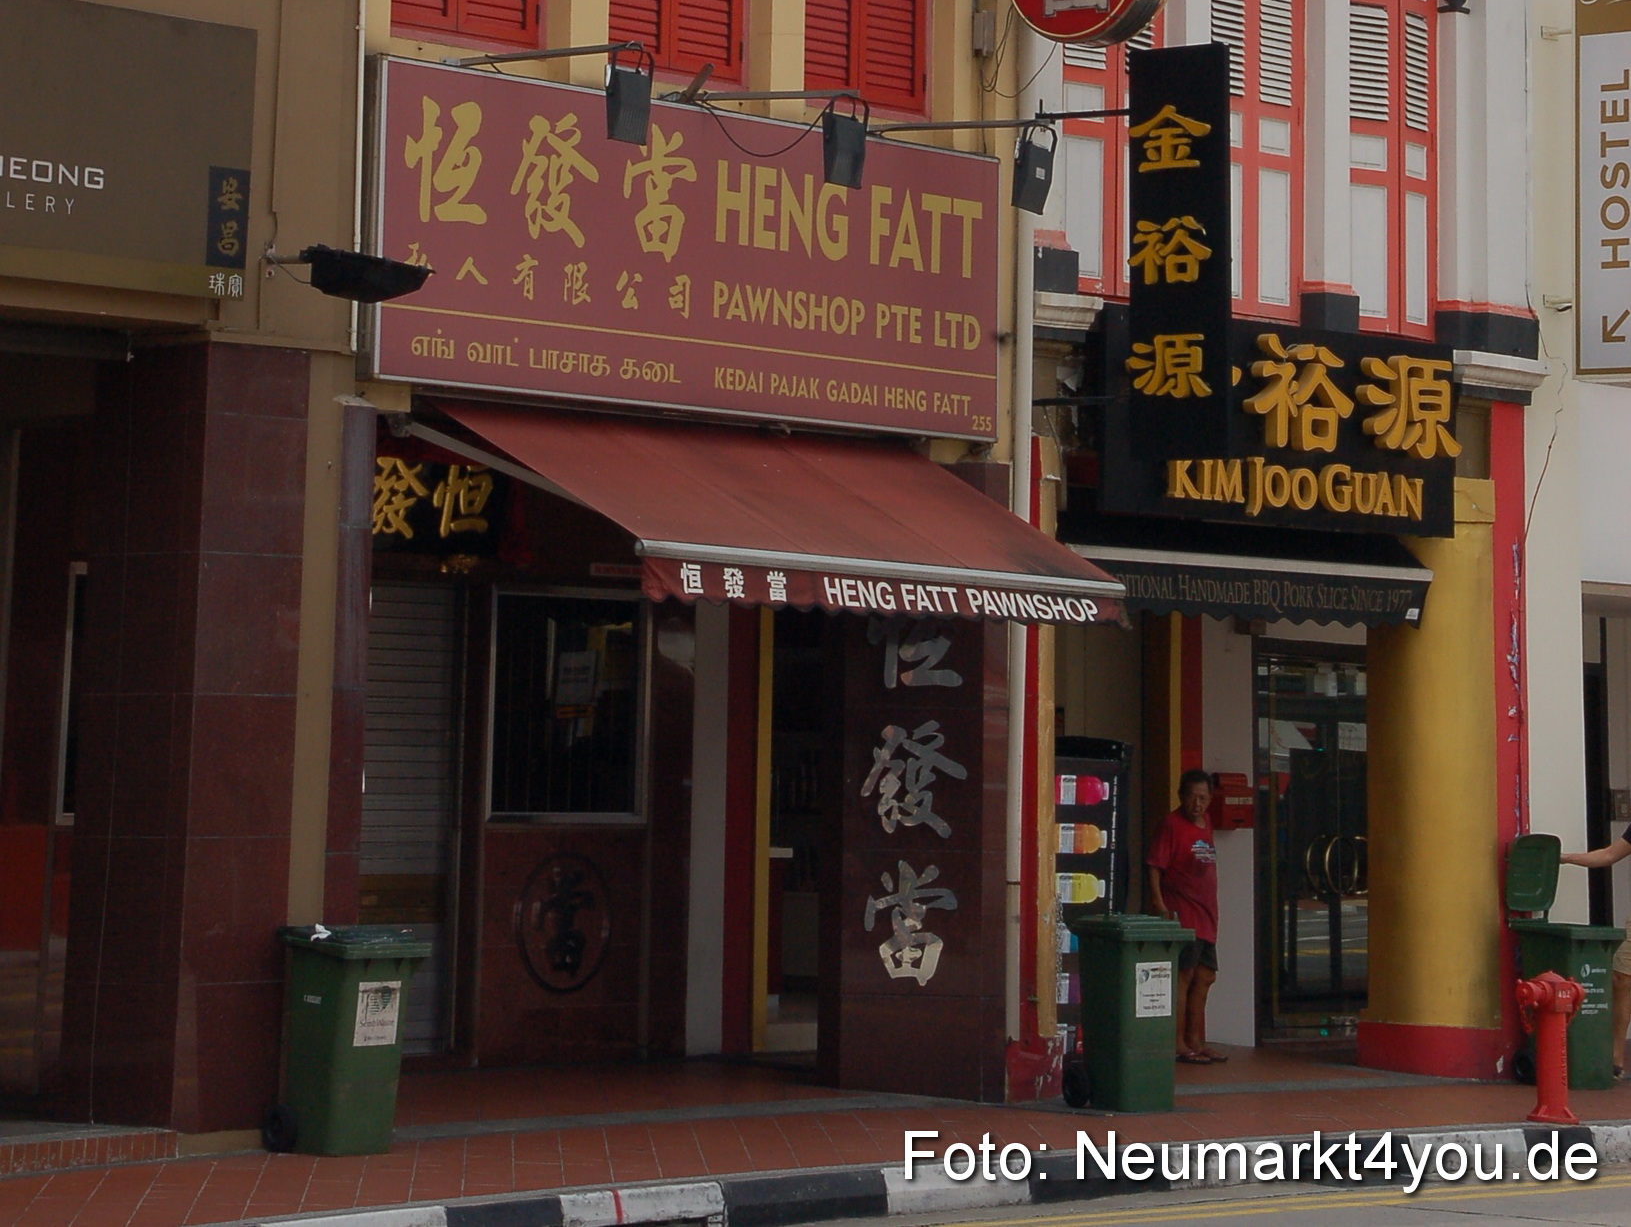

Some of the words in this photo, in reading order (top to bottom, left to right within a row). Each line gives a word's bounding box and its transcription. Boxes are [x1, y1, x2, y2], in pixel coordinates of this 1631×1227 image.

[1600, 68, 1631, 271] HOSTEL
[715, 159, 850, 262] HENG
[869, 184, 983, 279] FATT
[1125, 103, 1213, 399] 金裕源
[713, 280, 866, 336] PAWNSHOP
[876, 302, 923, 345] PTE
[934, 310, 982, 351] LTD
[714, 366, 764, 393] KEDAI
[770, 373, 820, 401] PAJAK
[826, 380, 878, 406] GADAI
[884, 387, 928, 412] HENG
[933, 392, 972, 417] FATT
[972, 415, 993, 432] 255
[1231, 333, 1463, 460] 裕源
[1167, 458, 1246, 504] KIM
[1246, 456, 1319, 517] JOO
[1320, 463, 1424, 521] GUAN
[822, 576, 897, 611] HENG
[900, 583, 960, 613] FATT
[968, 588, 1099, 623] PAWNSHOP
[1253, 579, 1284, 614] BBQ
[1284, 581, 1315, 609] PORK
[1317, 583, 1348, 610] SLICE
[1350, 585, 1384, 613] SINCE
